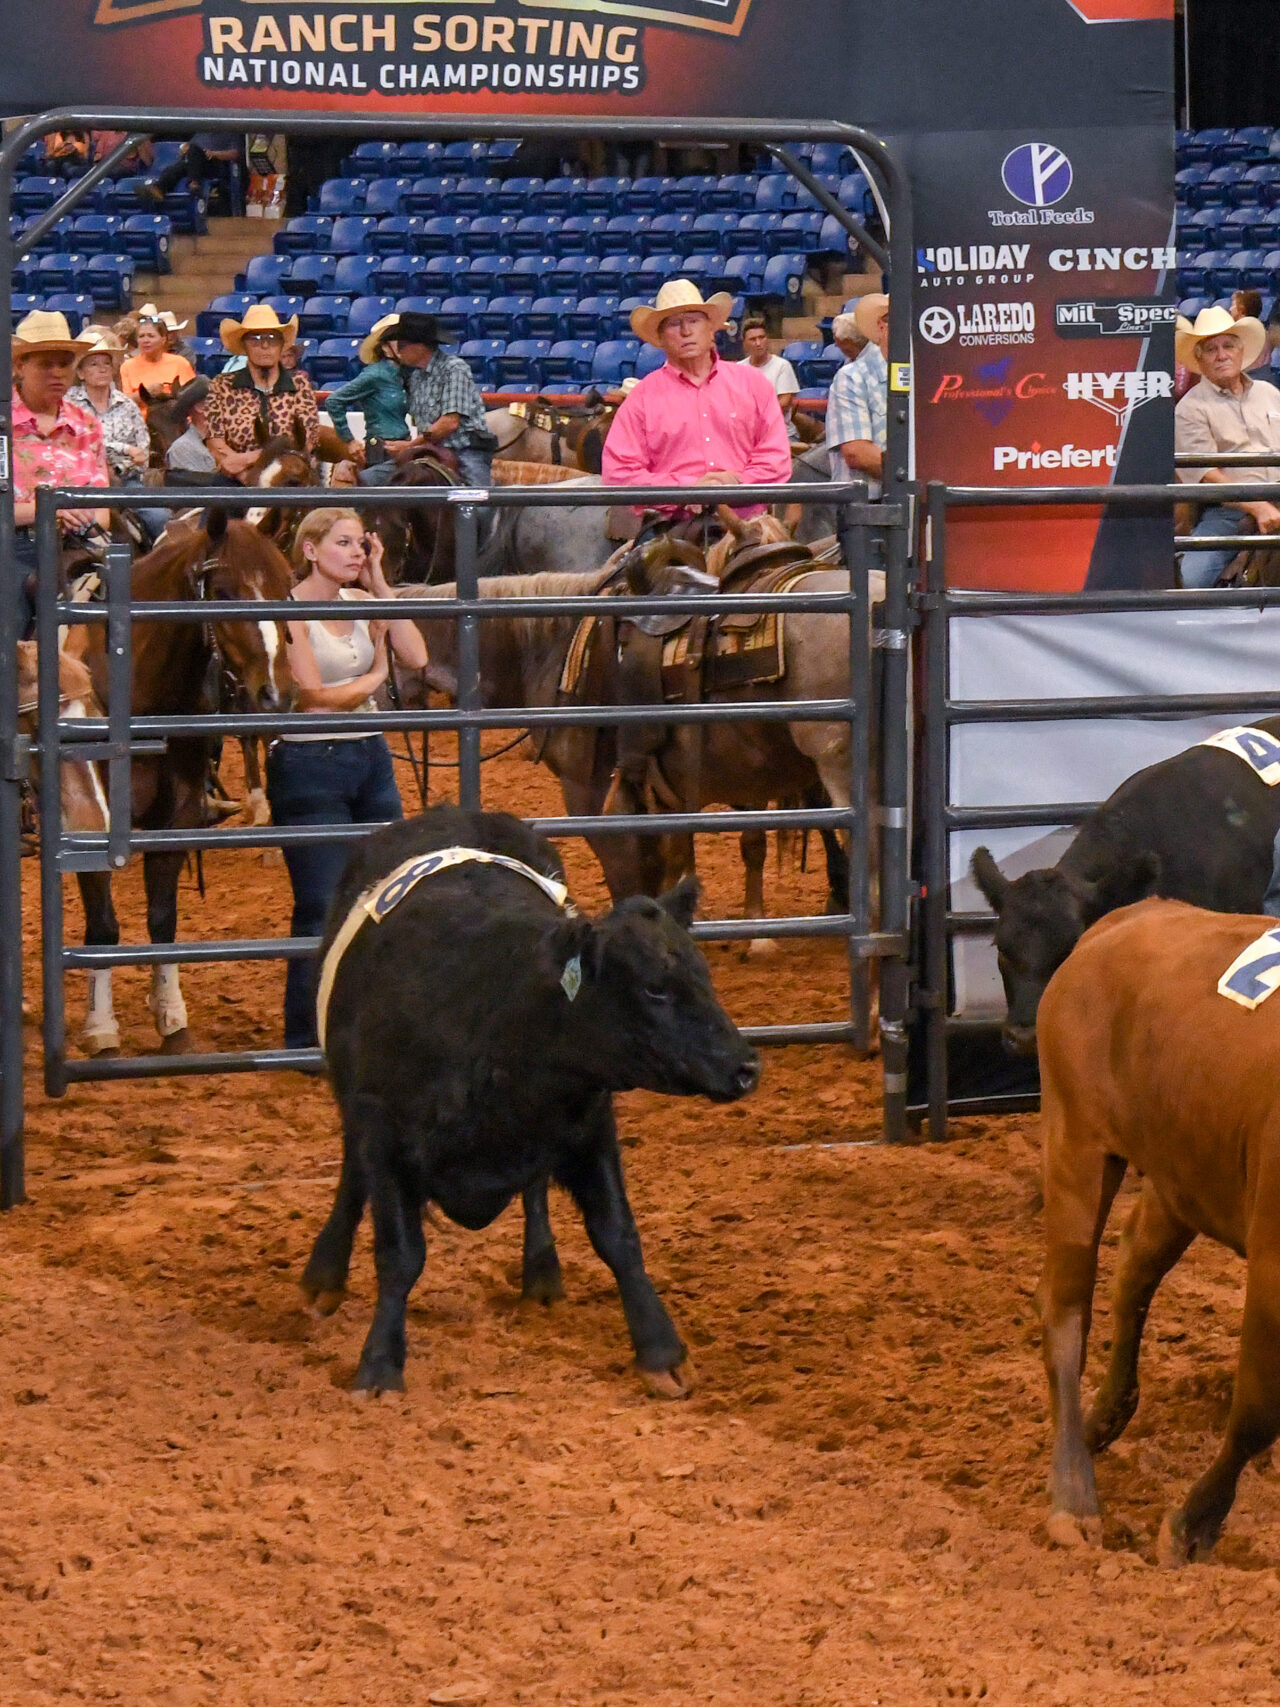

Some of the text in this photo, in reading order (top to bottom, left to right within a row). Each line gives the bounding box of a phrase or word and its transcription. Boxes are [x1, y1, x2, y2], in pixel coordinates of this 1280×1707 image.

[209, 14, 638, 63] RANCH SORTING
[203, 57, 641, 90] NATIONAL CHAMPIONSHIPS
[988, 207, 1095, 226] Total Feeds
[916, 244, 1031, 274] HOLIDAY
[1048, 247, 1177, 272] CINCH
[920, 273, 1035, 288] AUTO GROUP
[956, 302, 1035, 334] LAREDO
[1059, 305, 1176, 325] Mil Spec
[959, 332, 1035, 347] CONVERSIONS
[1067, 371, 1173, 400] HYER
[993, 441, 1117, 470] Priefert
[375, 855, 443, 916] 8
